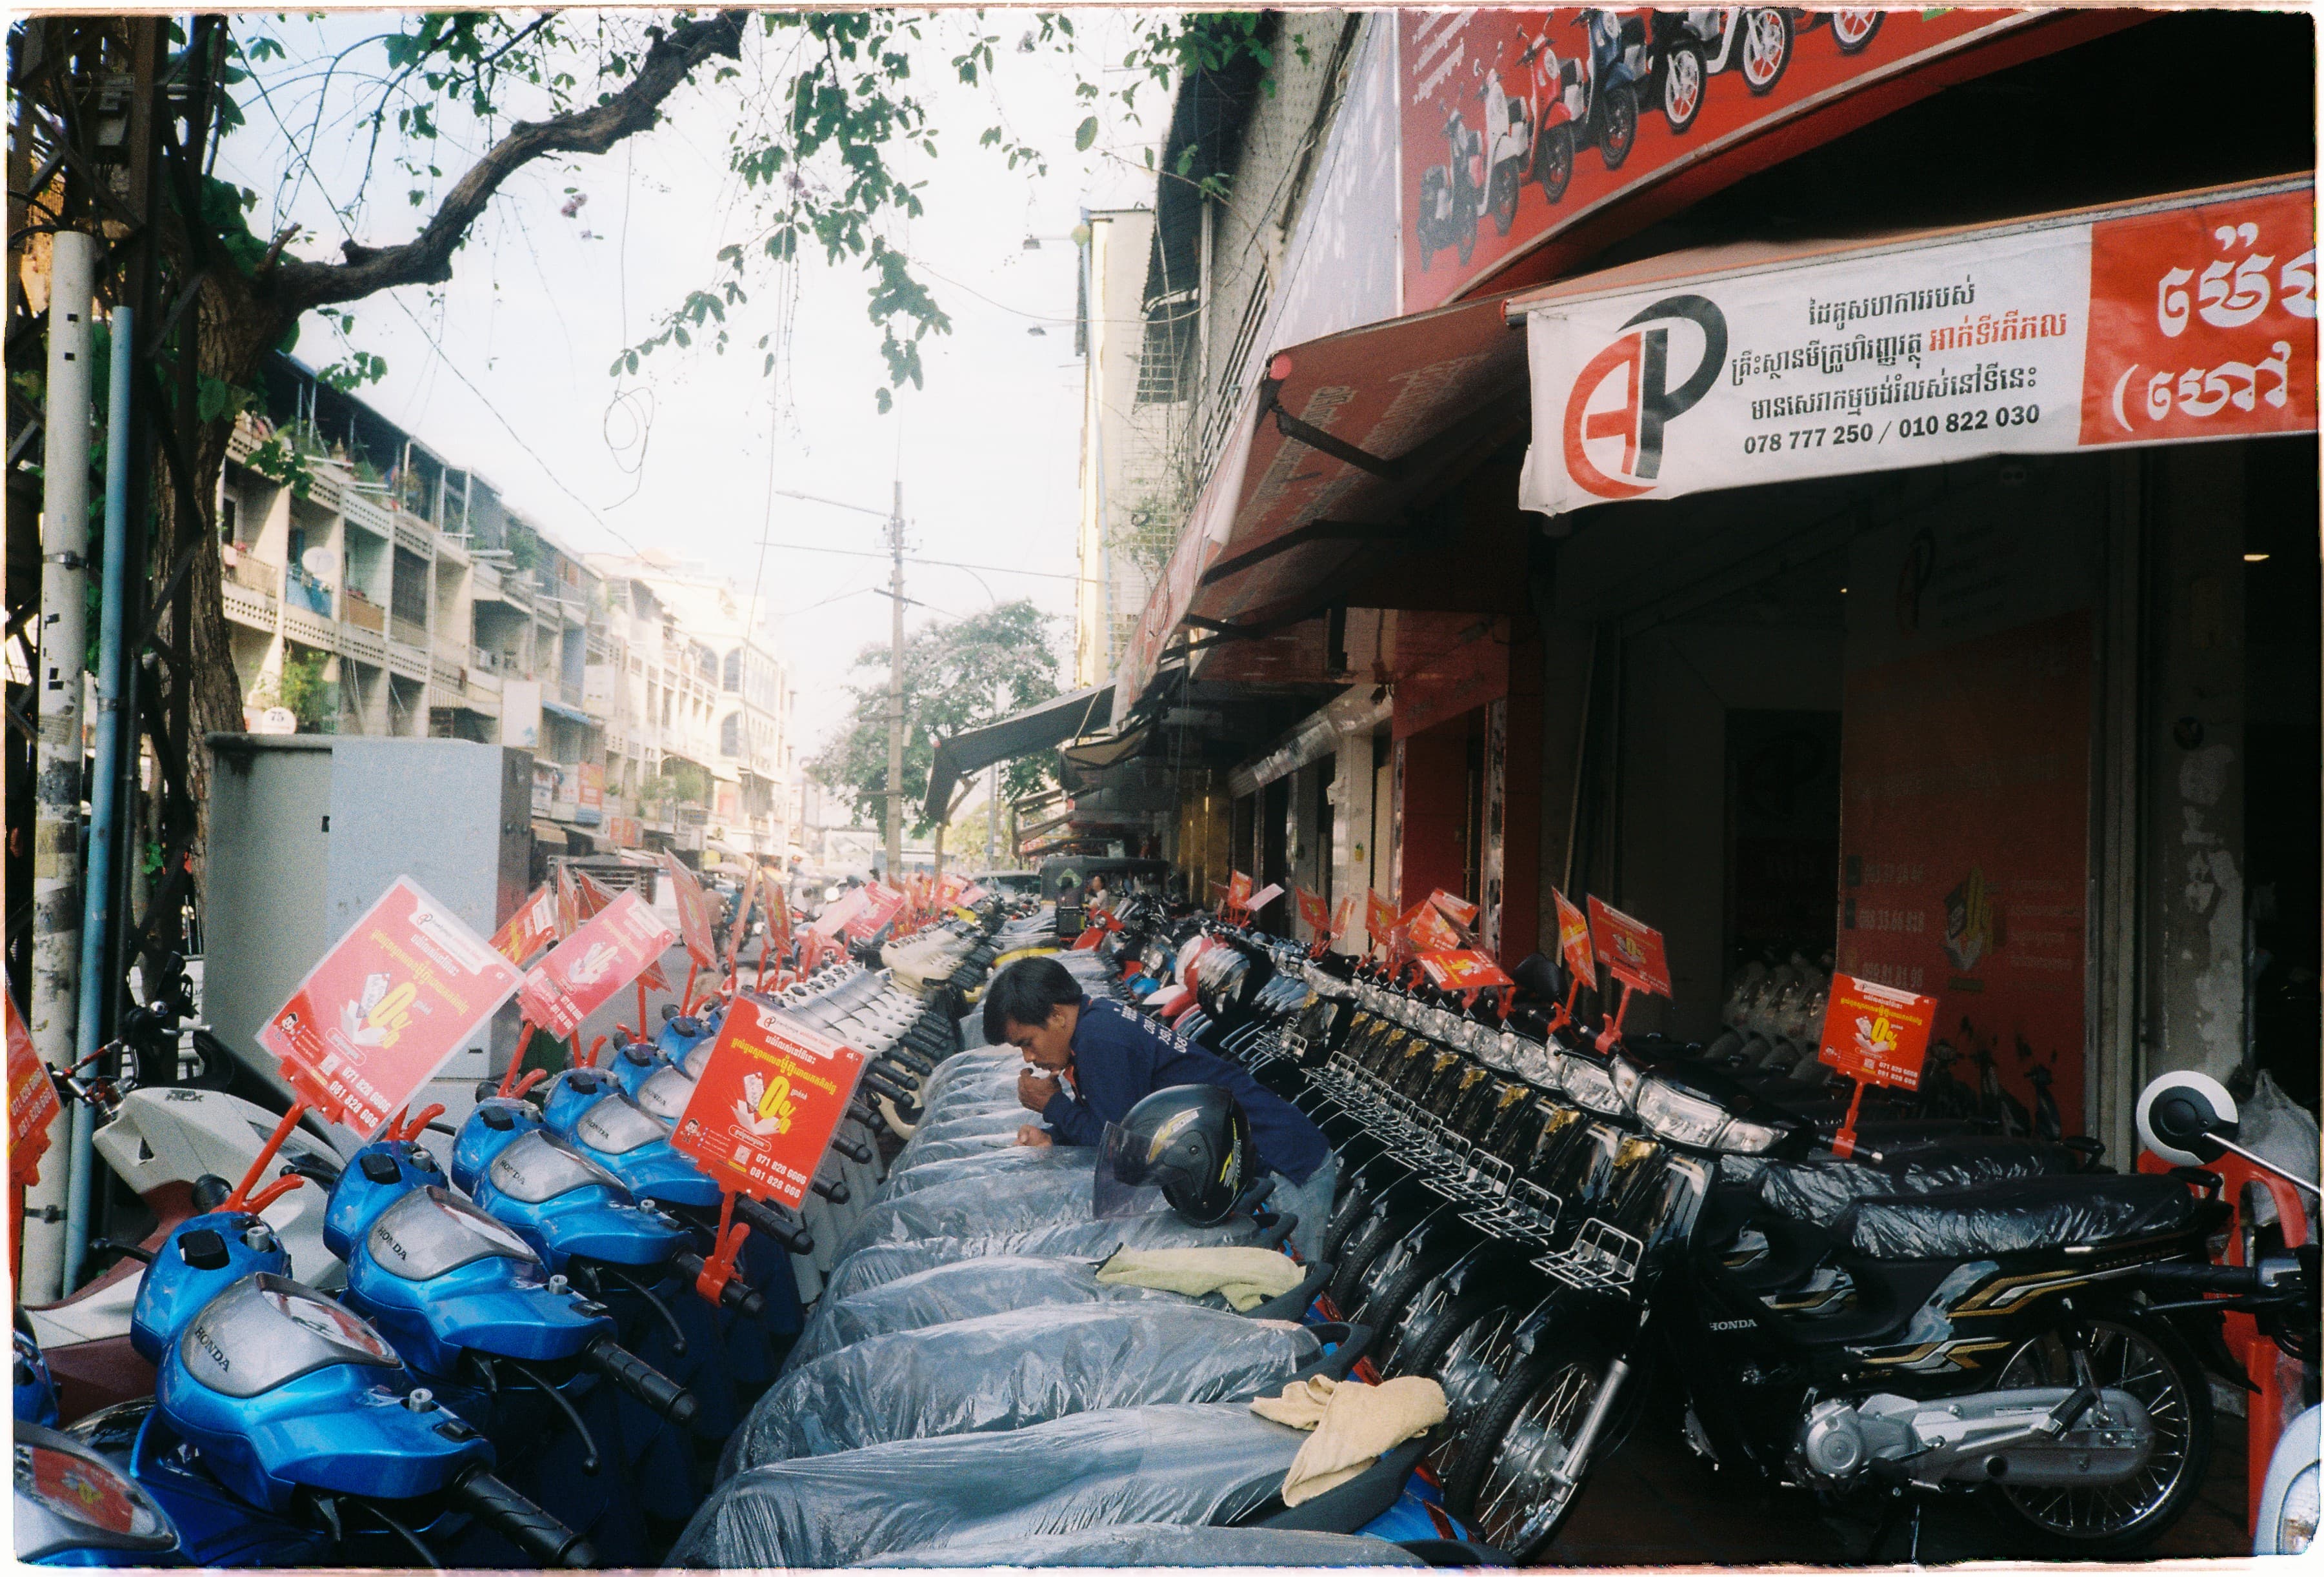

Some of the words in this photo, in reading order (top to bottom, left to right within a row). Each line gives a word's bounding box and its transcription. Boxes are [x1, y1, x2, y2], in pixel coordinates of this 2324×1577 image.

[1744, 430, 1782, 454] 078
[1789, 427, 1827, 450] 777
[1833, 423, 1873, 446] 250
[1899, 416, 1939, 439] 010
[1946, 409, 1988, 434] 822
[1996, 403, 2041, 427] 030
[757, 1076, 797, 1134] 0%
[756, 1152, 770, 1167] 071
[771, 1160, 786, 1174] 828
[750, 1165, 765, 1181] 081
[766, 1174, 783, 1190] 828
[784, 1181, 801, 1199] 666
[377, 1226, 407, 1261] HONDA
[1709, 1318, 1758, 1331] HONDA
[195, 1325, 230, 1373] HONDA
